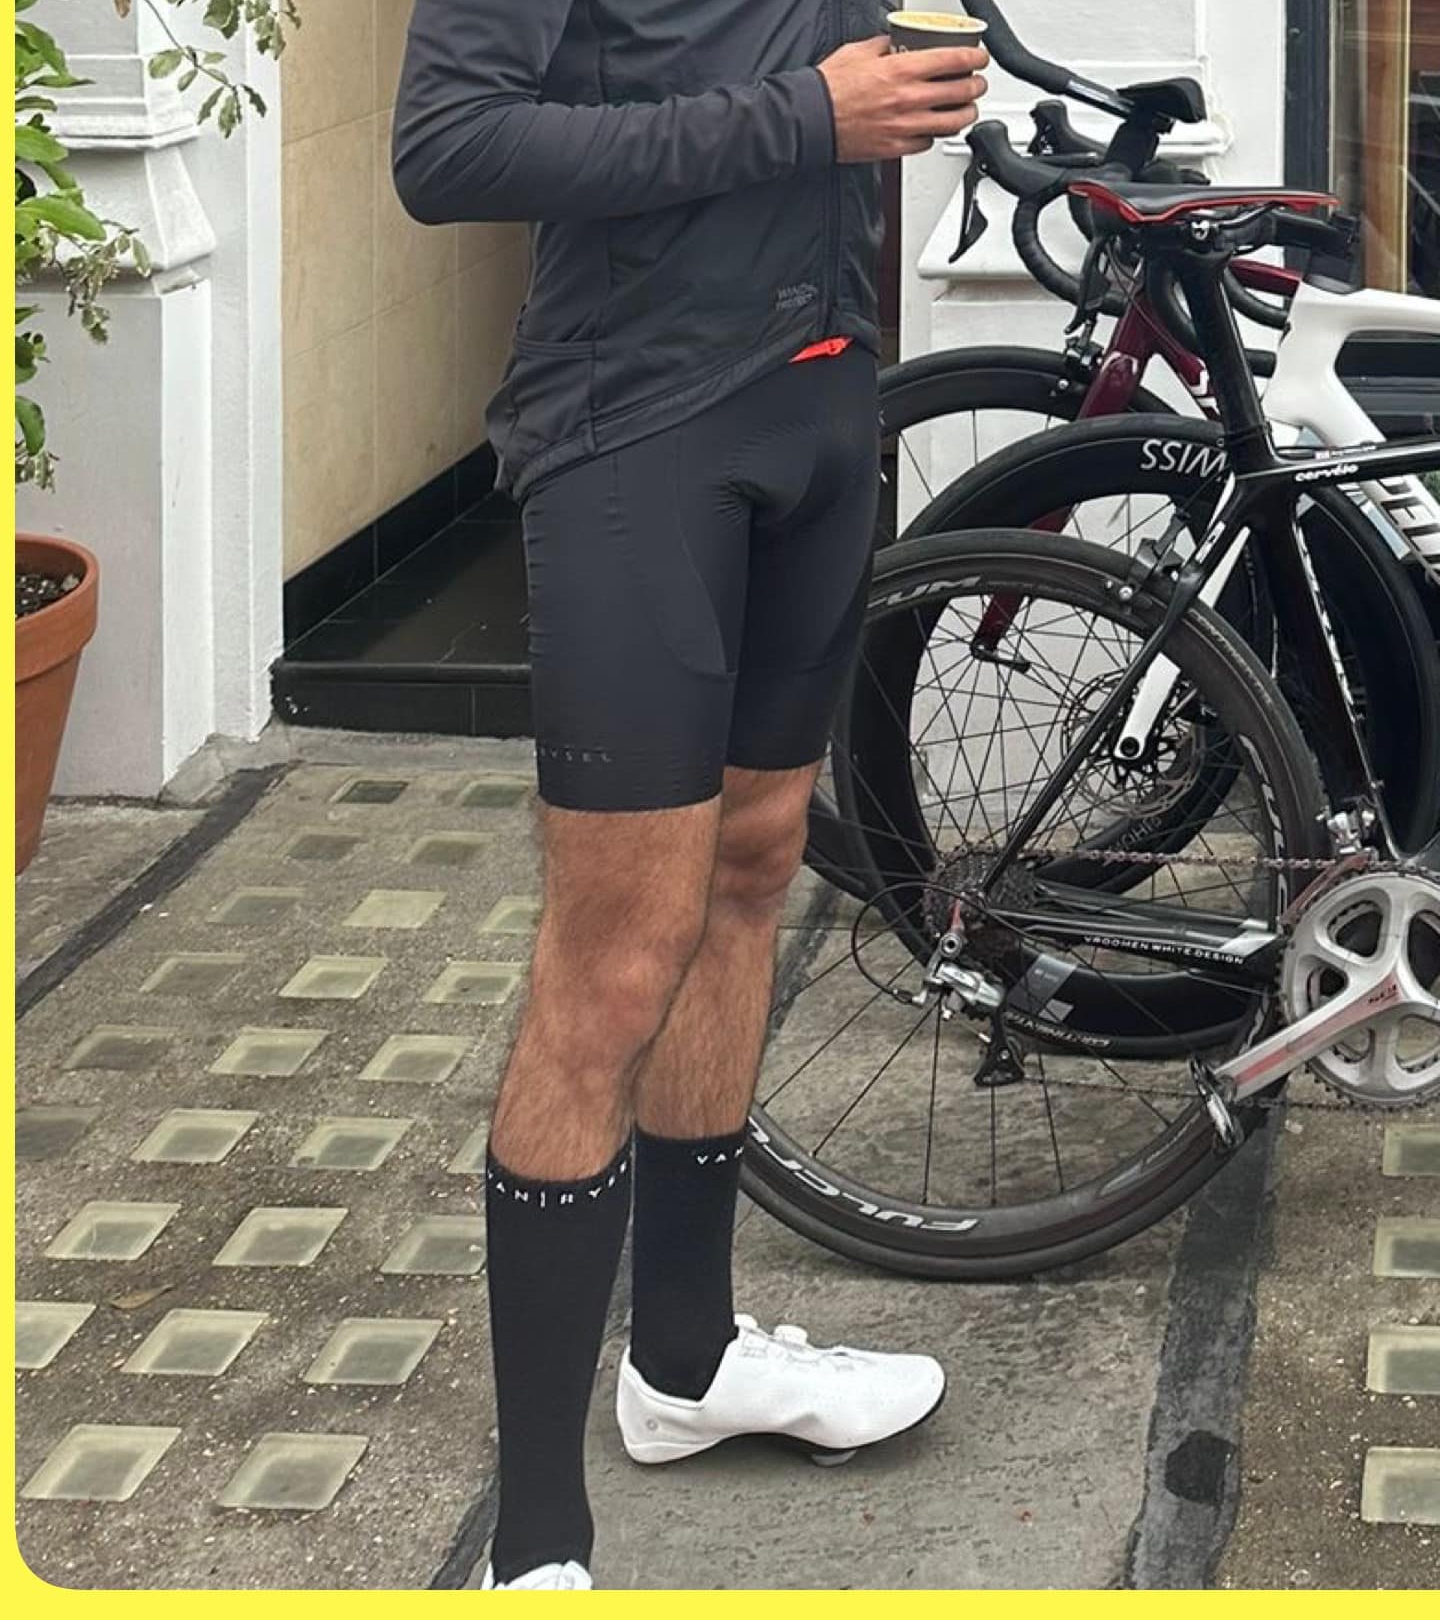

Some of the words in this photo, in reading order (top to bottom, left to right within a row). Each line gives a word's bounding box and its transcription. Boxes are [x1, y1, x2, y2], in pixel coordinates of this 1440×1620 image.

[1140, 438, 1228, 481] WISS
[1151, 943, 1194, 958] WHITE
[1195, 948, 1245, 965] DESIGN
